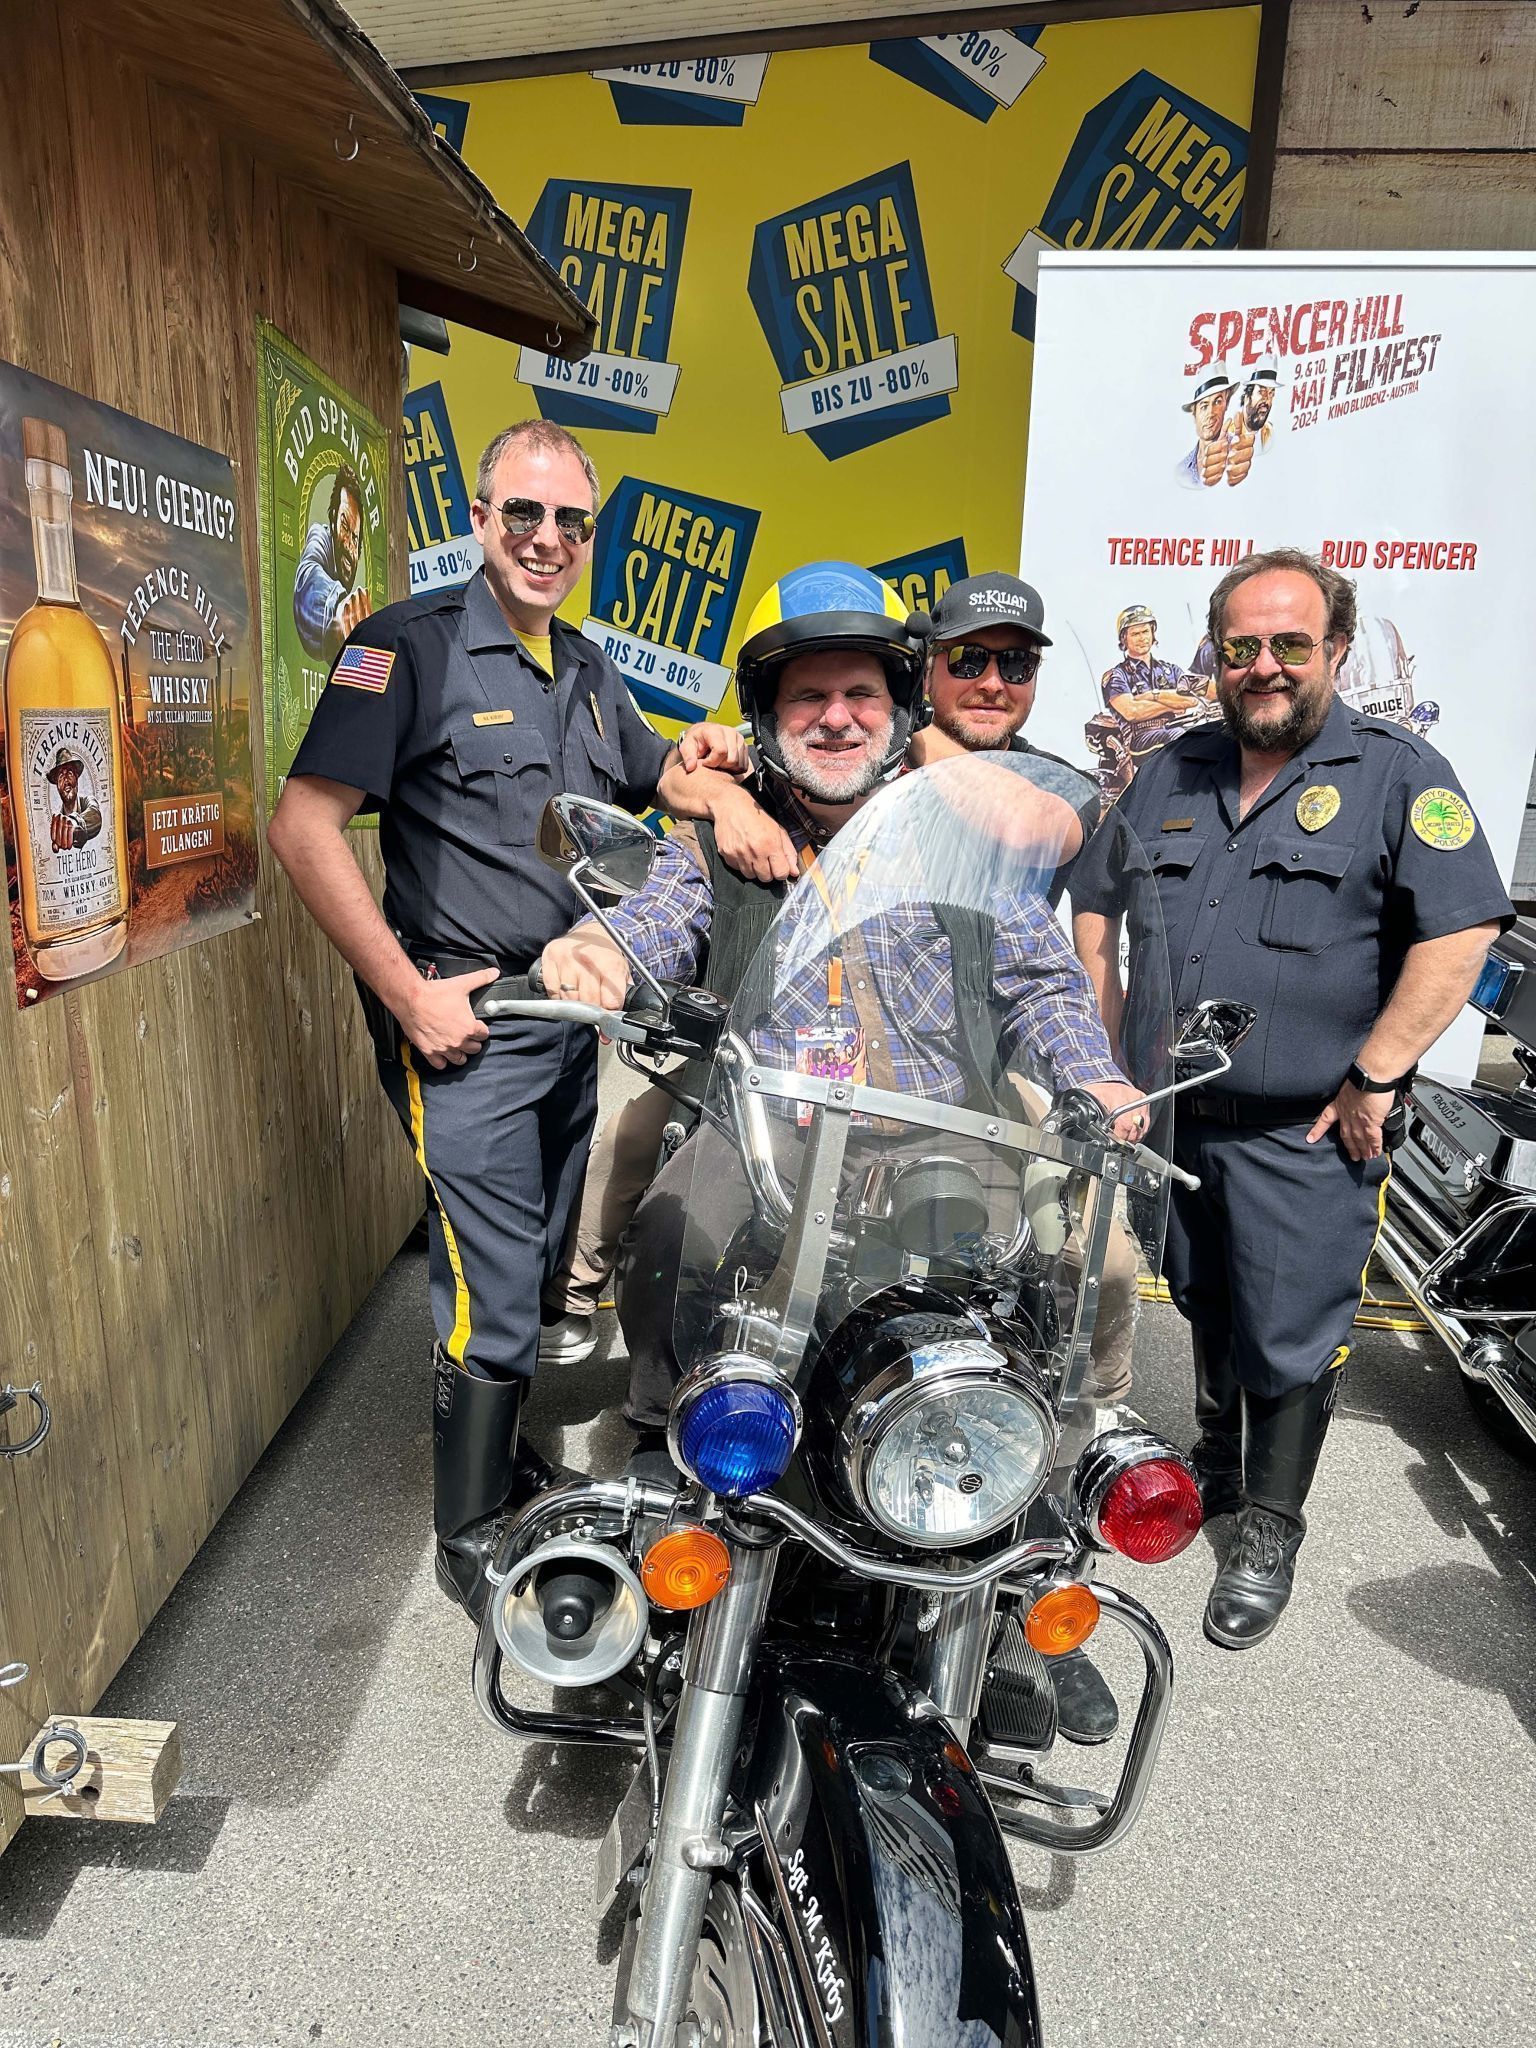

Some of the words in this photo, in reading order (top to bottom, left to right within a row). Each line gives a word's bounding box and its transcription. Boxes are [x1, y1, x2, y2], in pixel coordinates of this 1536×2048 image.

[687, 57, 736, 87] -80%
[957, 31, 1007, 78] -80%
[1124, 96, 1247, 231] MEGA
[563, 192, 668, 270] MEGA
[783, 196, 907, 280] MEGA
[796, 259, 920, 376] SALE
[1184, 300, 1348, 376] SPENCER
[1351, 294, 1404, 344] HILL
[545, 355, 573, 382] BIS
[578, 361, 600, 387] ZU
[605, 368, 649, 398] -80%
[811, 384, 843, 415] BIS
[848, 376, 872, 405] ZU
[879, 359, 930, 394] -80%
[1330, 333, 1442, 400] FILMFEST
[1291, 409, 1318, 431] 2024
[1328, 400, 1350, 420] KINO
[403, 410, 444, 466] GA
[284, 405, 314, 486] BUD
[318, 395, 380, 535] SPENCER
[83, 448, 148, 518] NEU!
[155, 474, 235, 543] GIERIG?
[407, 463, 462, 551] LE
[632, 492, 736, 580] MEGA
[1107, 537, 1204, 566] TERENCE
[1321, 540, 1368, 569] BUD
[1373, 541, 1478, 570] SPENCER
[410, 560, 428, 584] ZU
[432, 549, 472, 578] -80%
[120, 566, 189, 646] TERENCE
[194, 584, 225, 657] HILL
[612, 549, 725, 660] SALE
[150, 630, 173, 665] THE
[175, 629, 205, 663] HERO
[604, 636, 631, 664] BIS
[634, 649, 657, 674] ZU
[660, 661, 703, 693] -80%
[149, 675, 209, 704] WHISKY
[302, 668, 326, 711] THE
[1362, 698, 1403, 715] POLICE
[33, 722, 79, 777] TERENCE
[82, 729, 103, 772] HILL
[152, 809, 178, 831] JETZT
[181, 802, 220, 826] KRÄFTIG
[1420, 790, 1435, 804] CITY
[1449, 795, 1471, 820] MIAMI
[57, 854, 74, 877] THE
[75, 848, 97, 873] HERO
[161, 829, 212, 855] ZULANGEN!
[1434, 837, 1463, 847] POLICE
[63, 879, 96, 899] WHISKY
[788, 1848, 809, 1902] Sgt.
[803, 1896, 823, 1943] M.
[815, 1935, 845, 2022] Kirby
